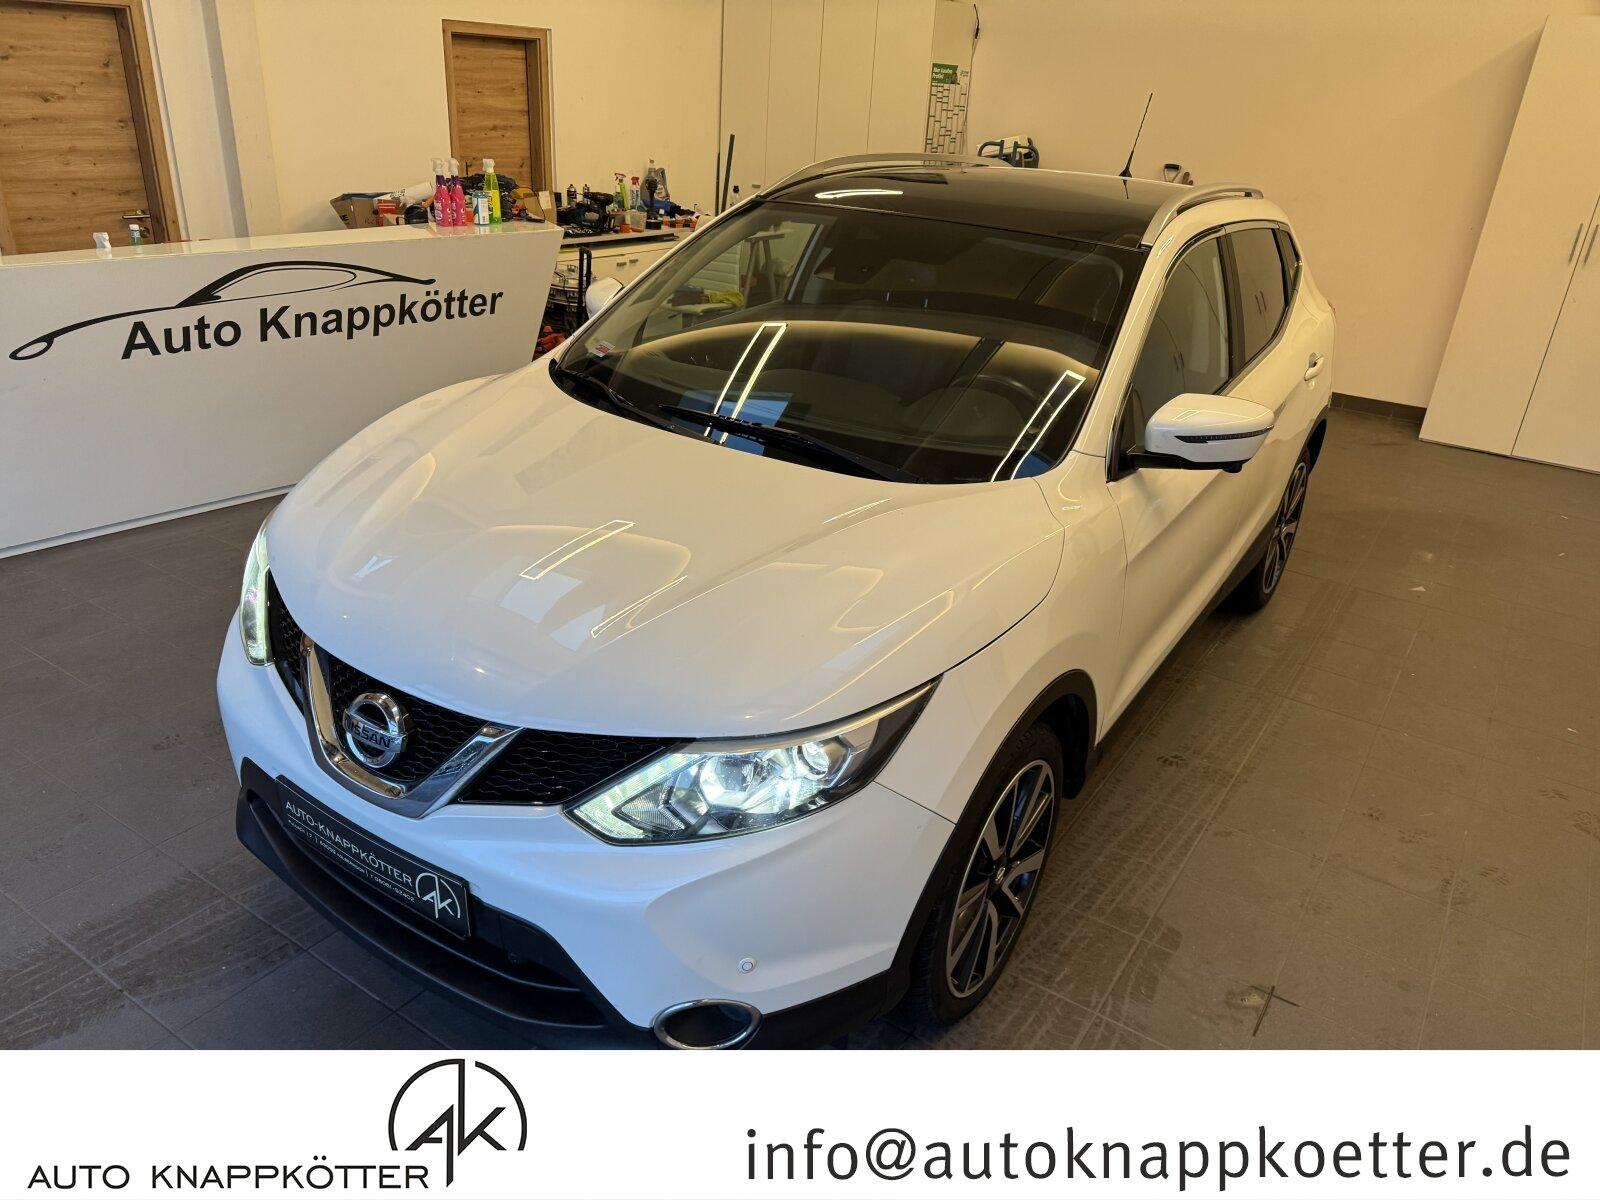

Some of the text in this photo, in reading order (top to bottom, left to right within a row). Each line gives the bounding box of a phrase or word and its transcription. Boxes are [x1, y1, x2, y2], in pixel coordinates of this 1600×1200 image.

[121, 288, 504, 360] Auto Knappkötter
[285, 801, 413, 887] AUTO-KNAPPKÖTTER
